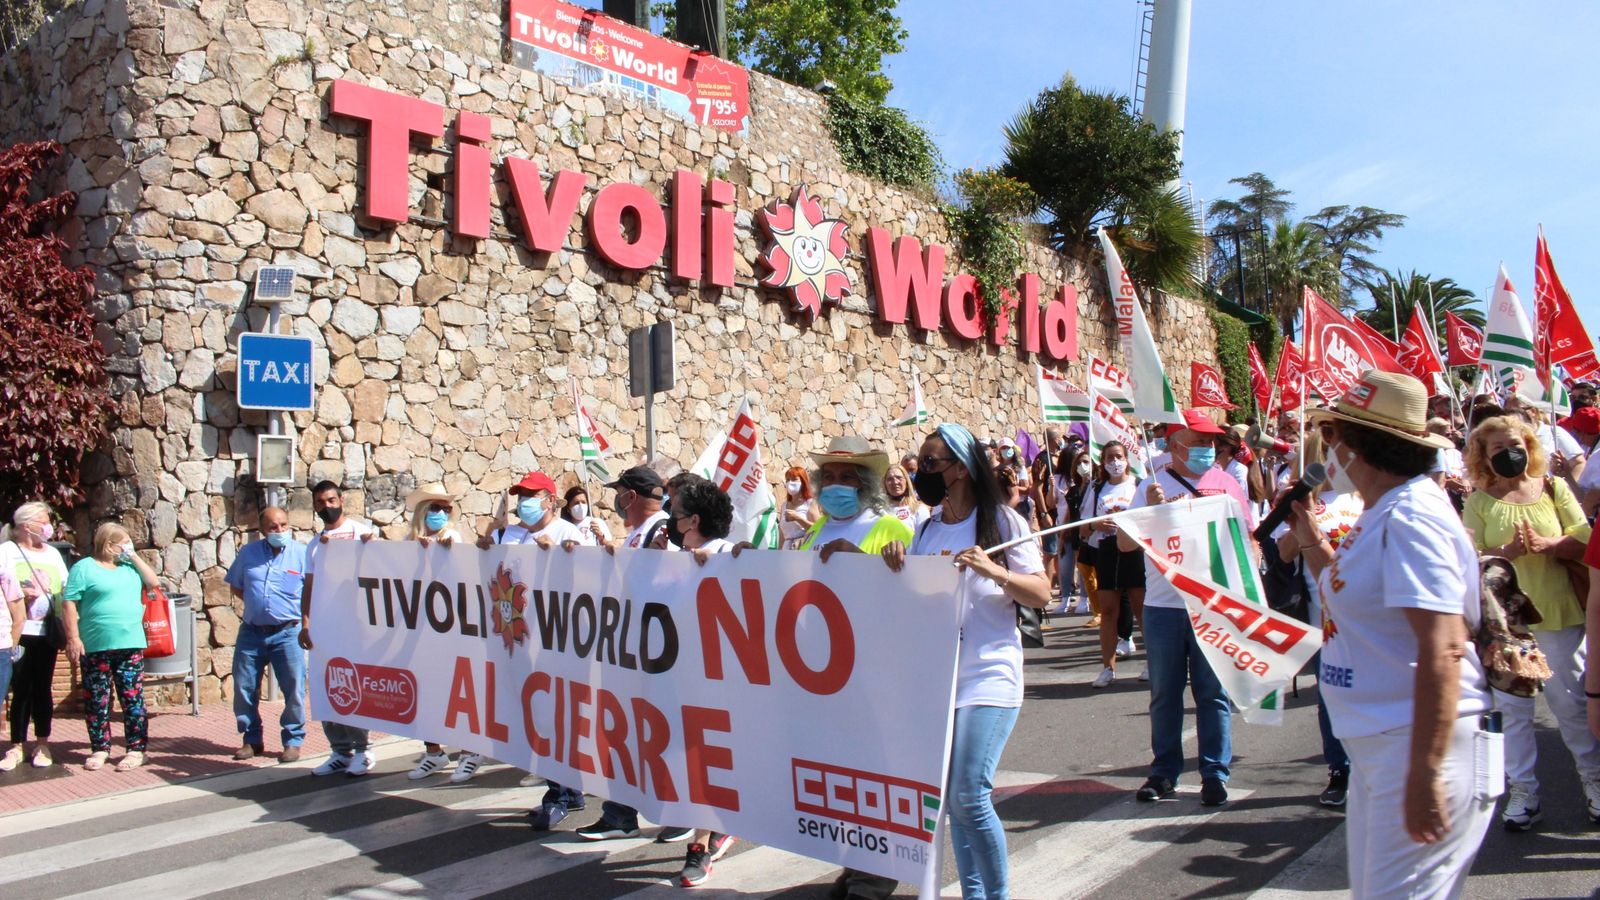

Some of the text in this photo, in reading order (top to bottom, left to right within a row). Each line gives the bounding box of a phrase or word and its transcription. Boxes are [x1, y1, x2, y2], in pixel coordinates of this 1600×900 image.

[515, 12, 678, 85] Tivoli World
[608, 28, 644, 49] Welcome
[331, 79, 1079, 362] Tivoli World
[243, 360, 310, 384] TAXI
[358, 576, 856, 696] TIVOLI WORLD NO
[1191, 613, 1270, 677] Málaga
[328, 665, 355, 692] UGT
[362, 676, 407, 695] FeSMC
[445, 656, 740, 813] AL CIERRE
[795, 766, 921, 830] CCOO
[798, 816, 889, 855] servicios
